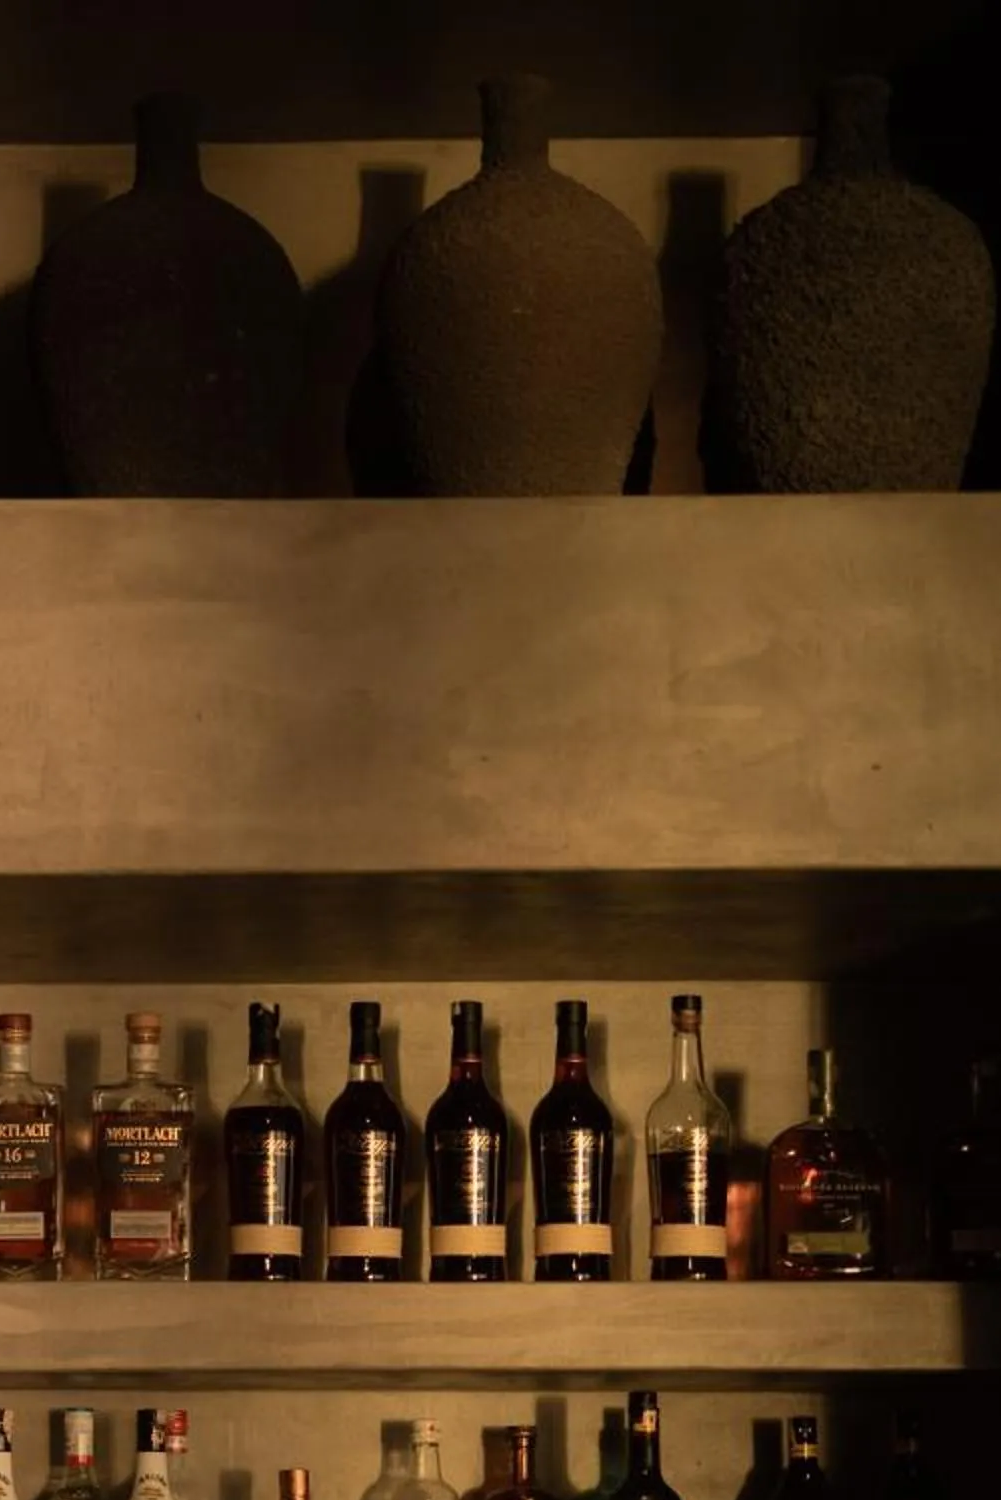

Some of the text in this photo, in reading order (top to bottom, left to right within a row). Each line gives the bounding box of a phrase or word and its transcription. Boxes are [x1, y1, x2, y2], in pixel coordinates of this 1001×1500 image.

[106, 1126, 179, 1141] MORTLACH
[4, 1147, 22, 1163] 16
[134, 1151, 151, 1165] 12
